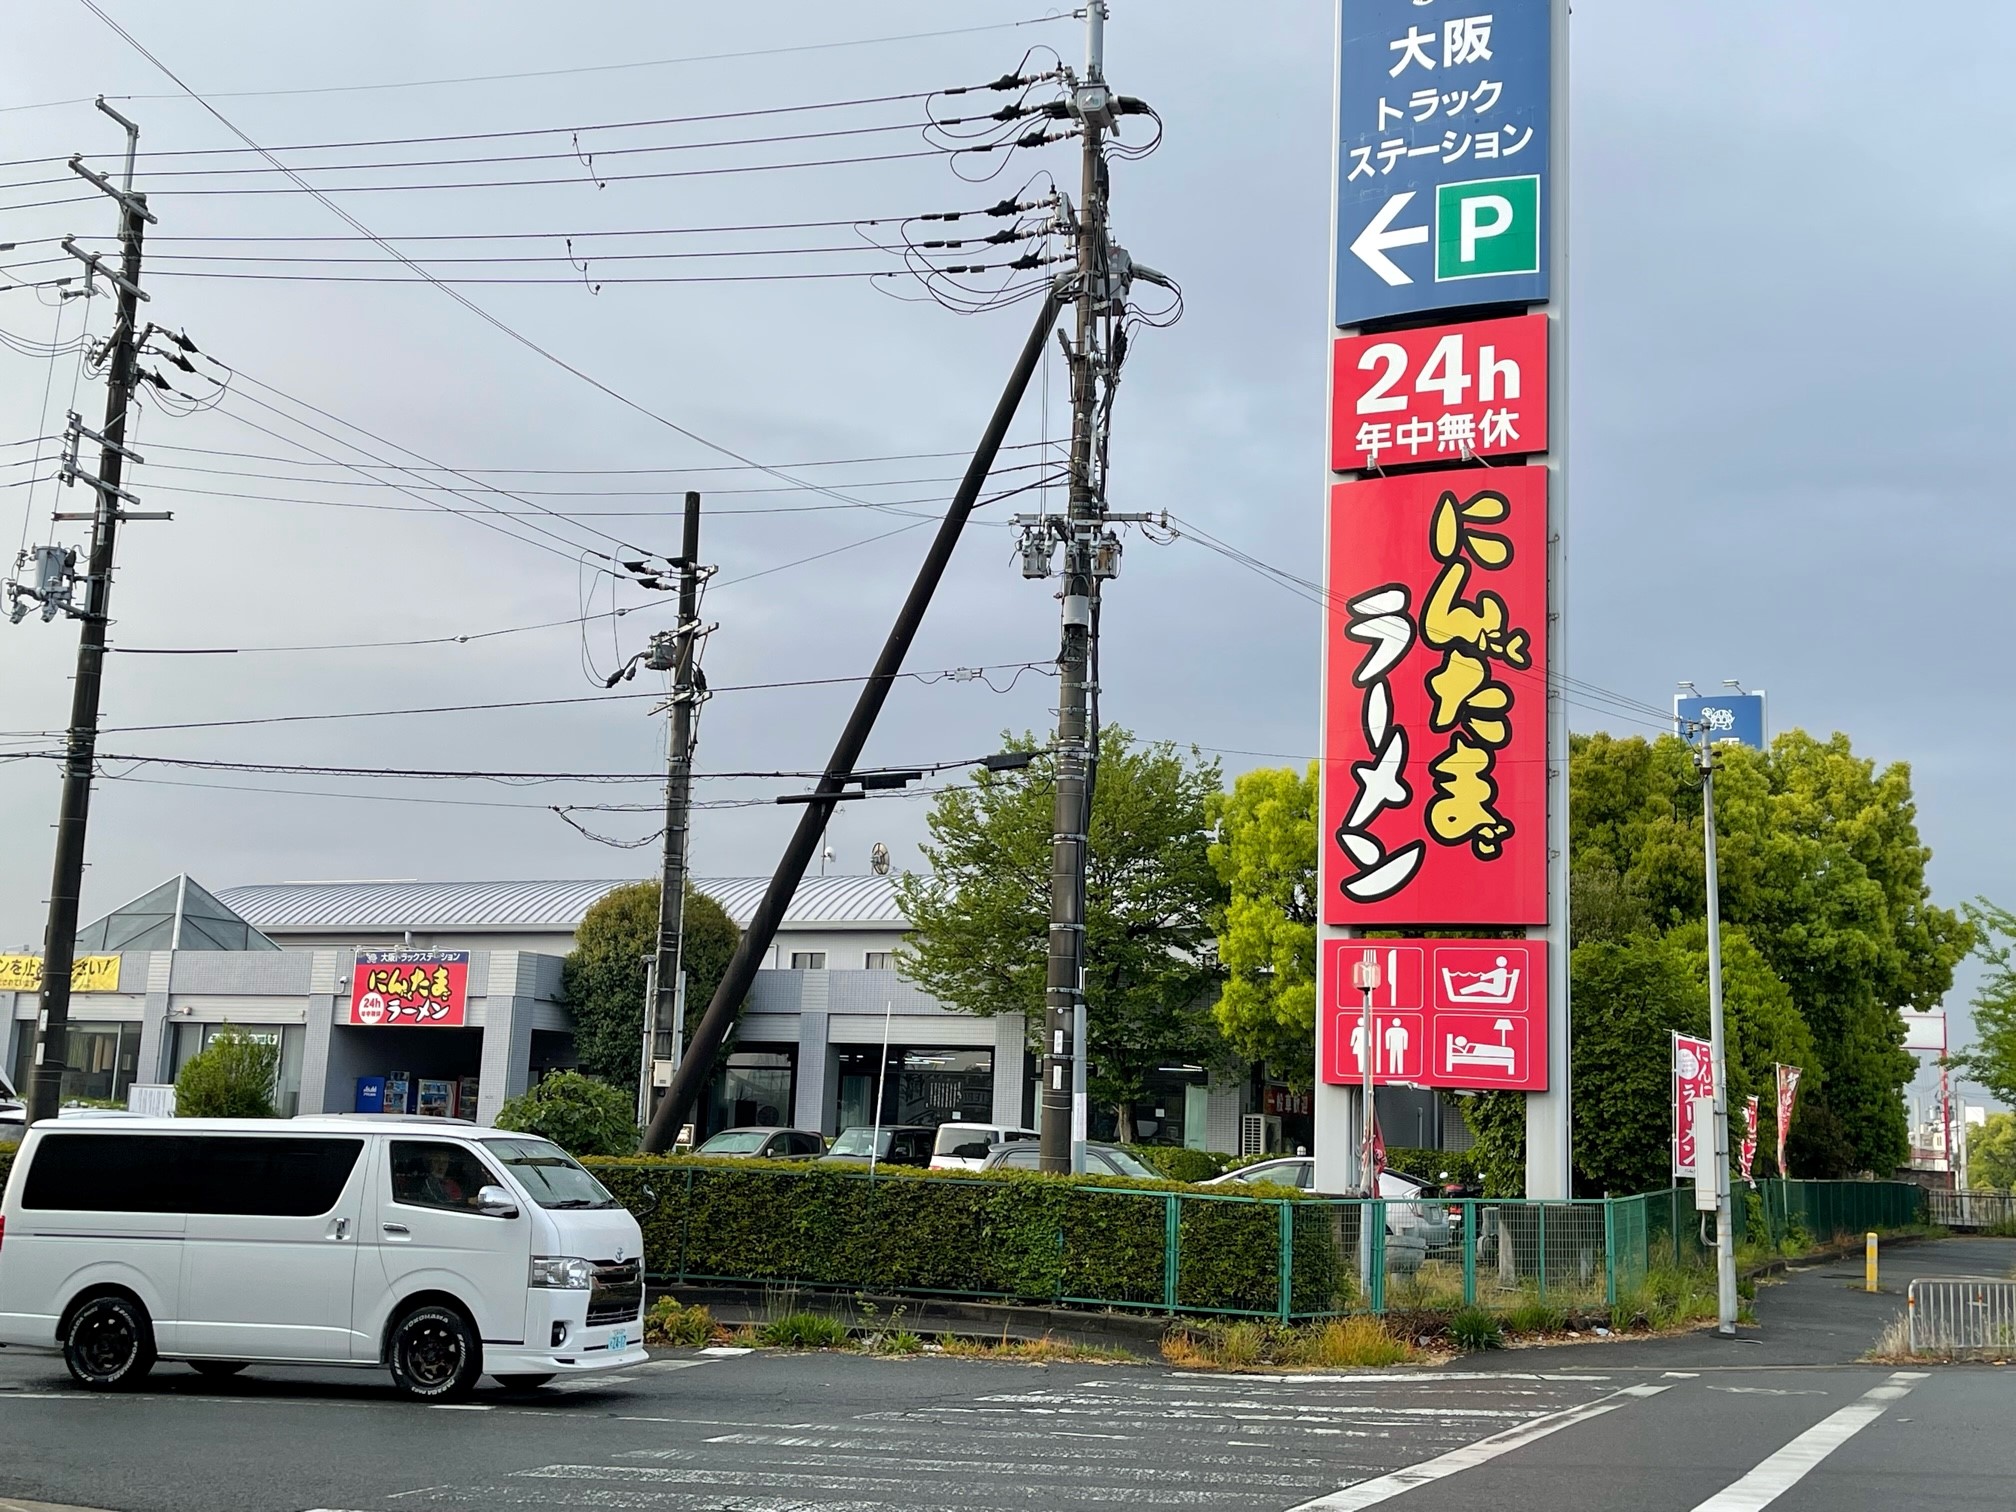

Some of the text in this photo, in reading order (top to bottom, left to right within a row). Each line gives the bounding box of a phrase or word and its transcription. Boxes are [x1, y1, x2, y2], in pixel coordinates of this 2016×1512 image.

[1389, 14, 1493, 78] 大阪
[1378, 79, 1503, 132] トラック
[1347, 124, 1534, 182] ステーション
[1460, 194, 1514, 263] P
[1356, 333, 1521, 415] 24h
[1355, 408, 1520, 456] 年中無休
[1336, 584, 1426, 903] ラーメン
[381, 953, 460, 962] 大阪トラックステション
[363, 998, 381, 1008] 24h
[387, 999, 450, 1023] ラーメン
